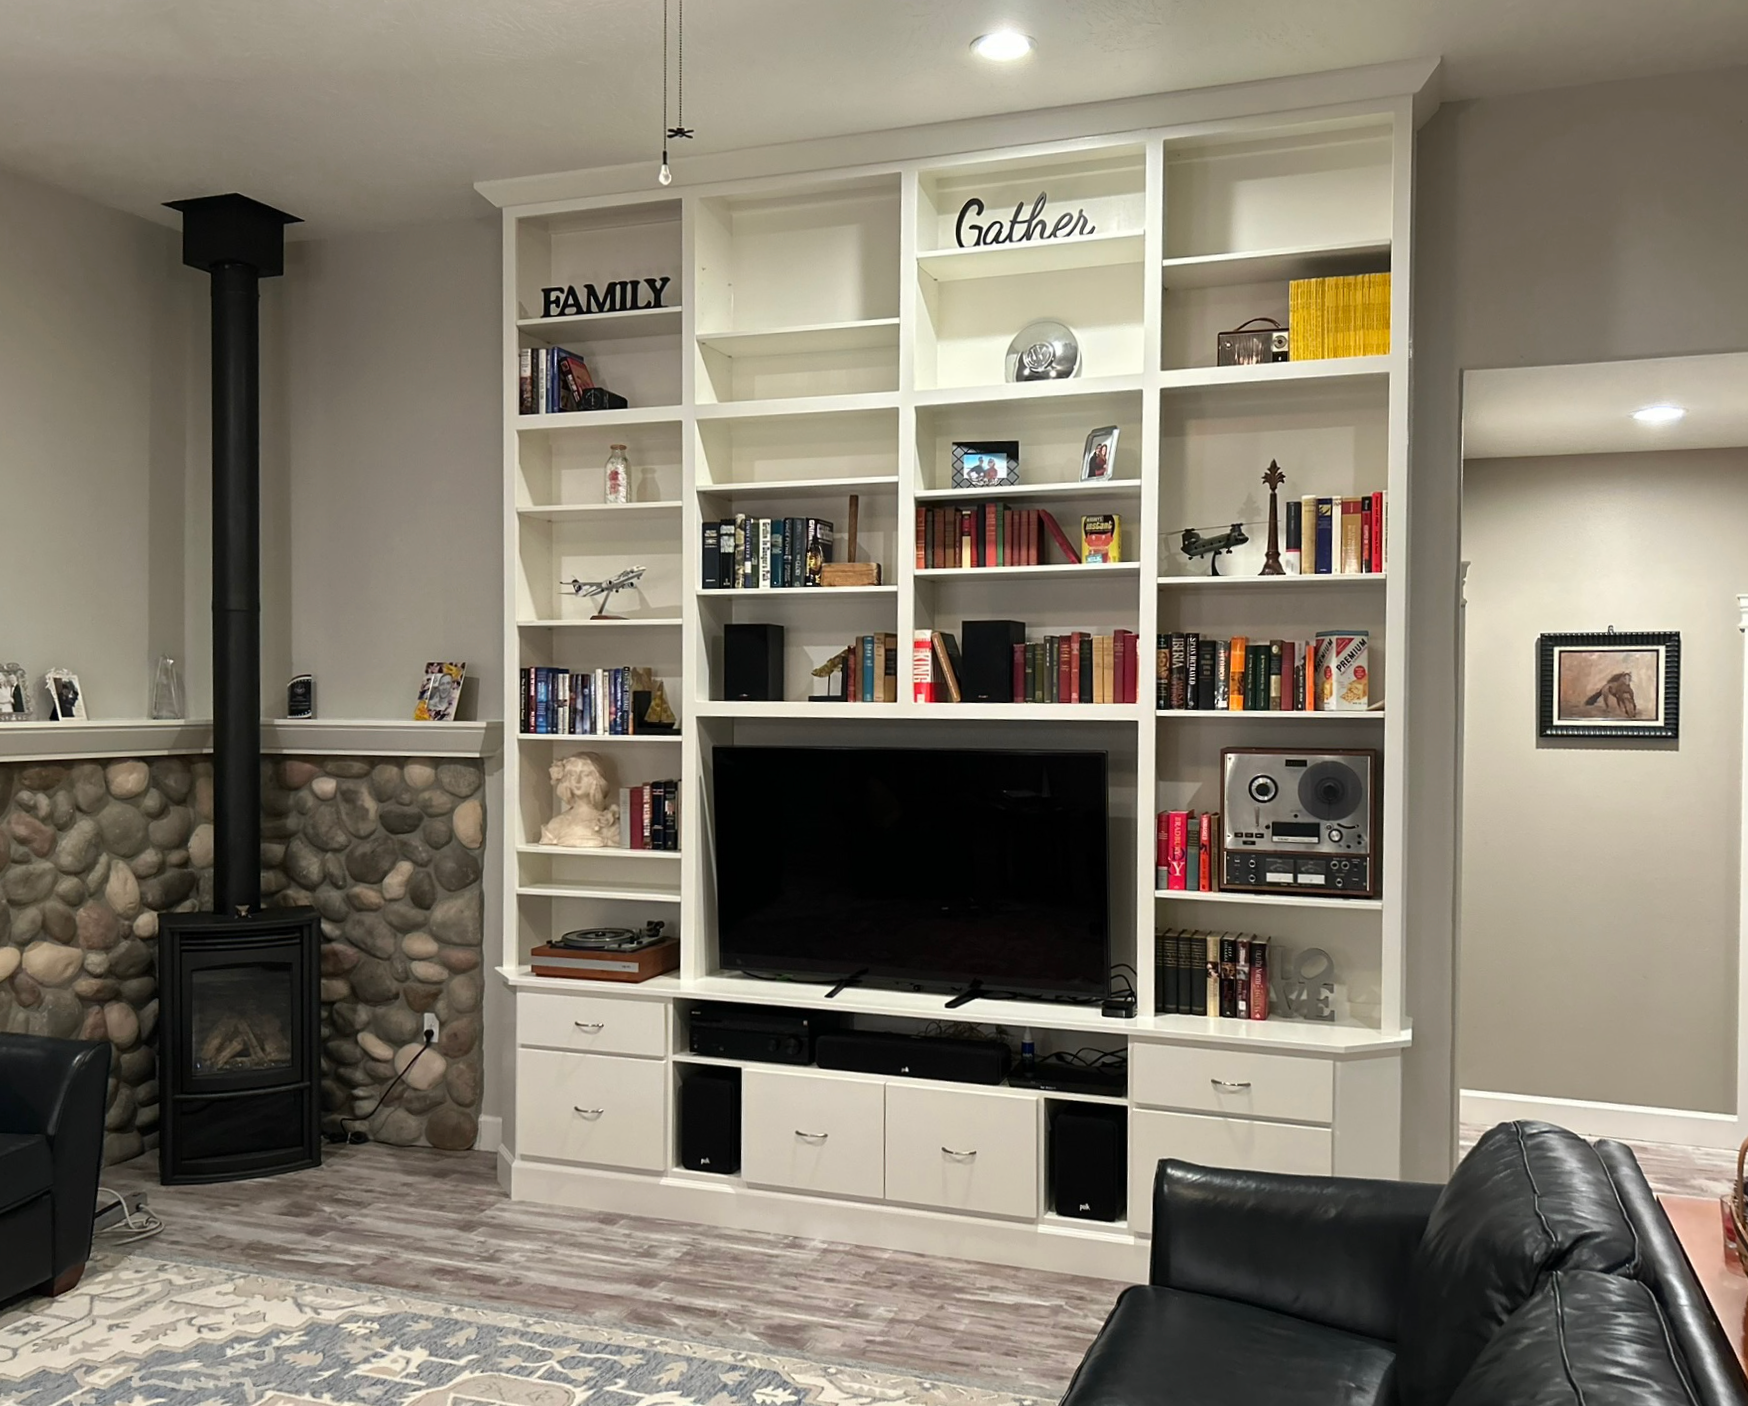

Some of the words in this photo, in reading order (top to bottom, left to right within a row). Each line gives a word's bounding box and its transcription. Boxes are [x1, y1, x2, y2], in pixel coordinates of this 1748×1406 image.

[955, 191, 1096, 248] Gather
[540, 276, 671, 318] FAMILY
[913, 653, 930, 683] KING
[1171, 638, 1185, 668] IBERIA
[1336, 637, 1367, 673] PREMIUM
[1188, 655, 1196, 685] BETRAYED
